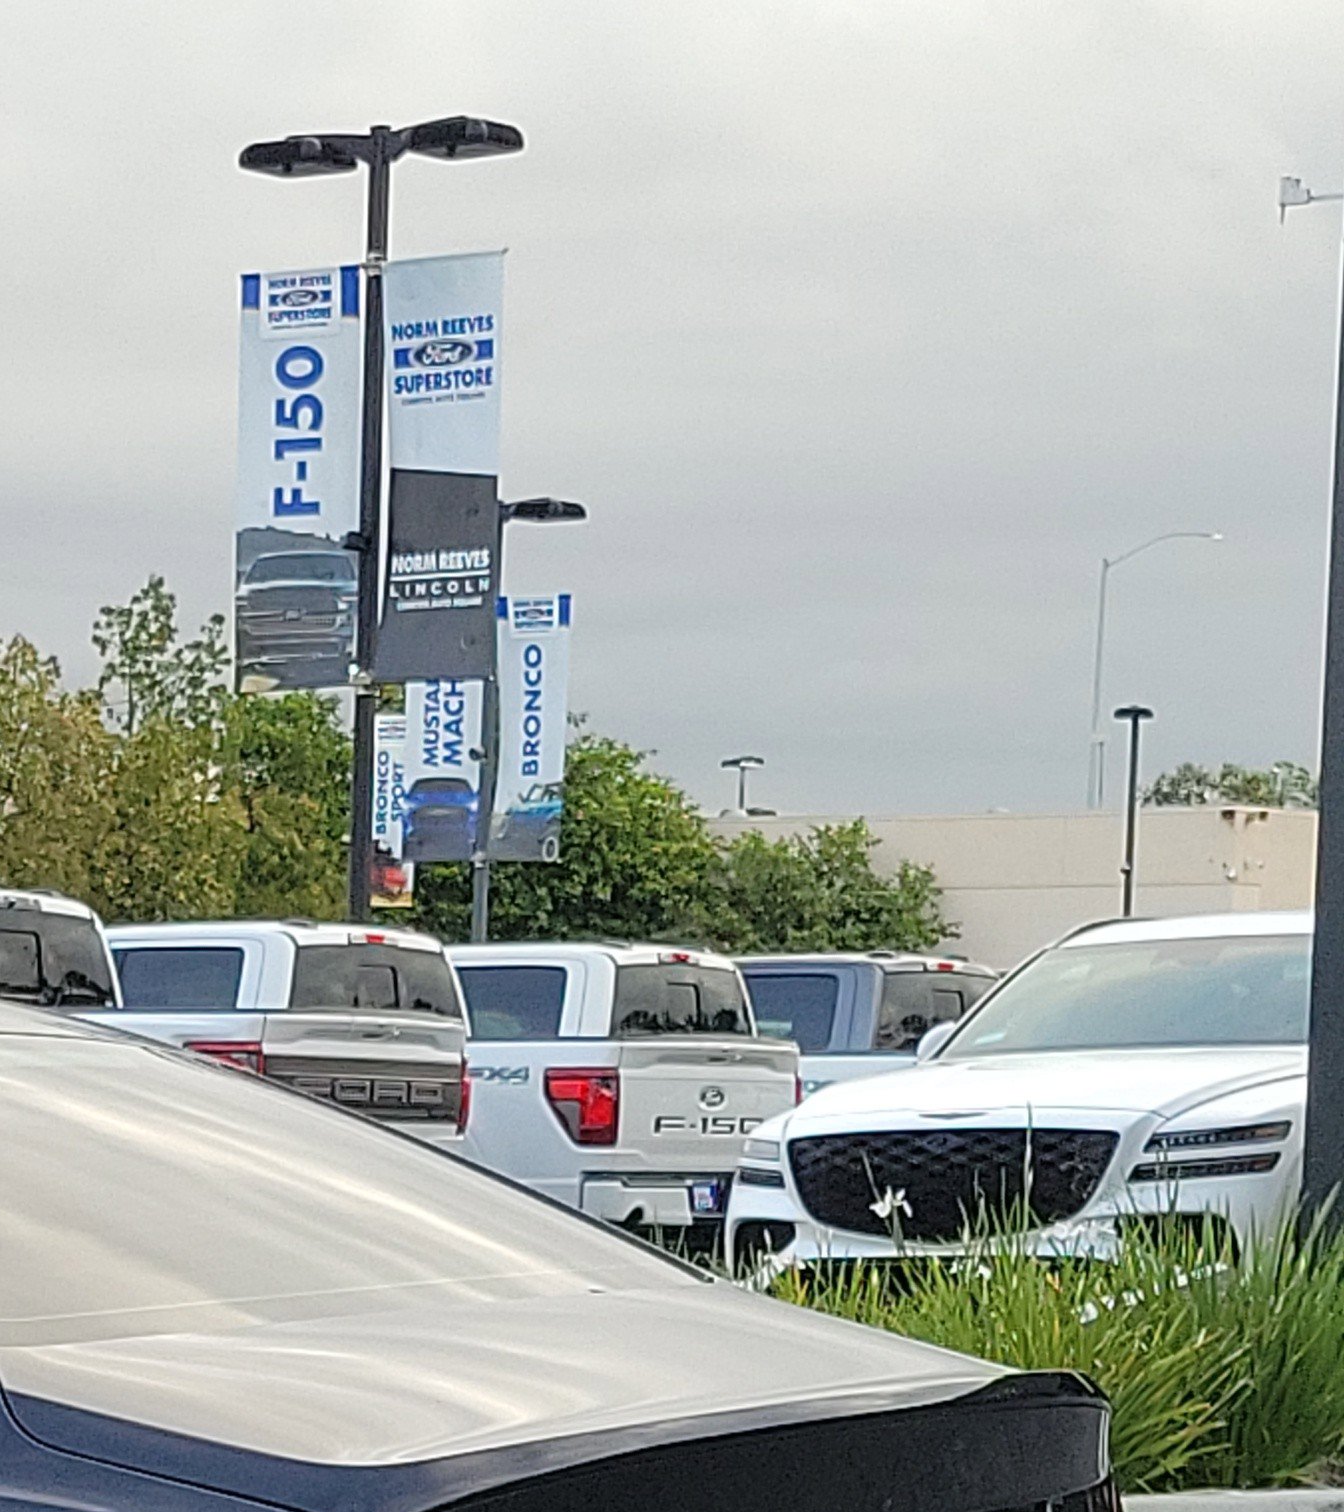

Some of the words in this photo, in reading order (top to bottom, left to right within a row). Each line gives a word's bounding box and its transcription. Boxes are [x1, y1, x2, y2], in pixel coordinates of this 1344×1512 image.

[391, 321, 439, 341] NORM
[441, 314, 494, 335] REEVES
[394, 366, 494, 394] SUPERSTORE
[273, 345, 325, 517] F-150
[391, 552, 438, 574] NORM
[439, 548, 491, 570] REEVES
[389, 577, 491, 598] LINCOLN
[521, 644, 542, 777] BRONCO
[374, 750, 390, 836] BRONCO
